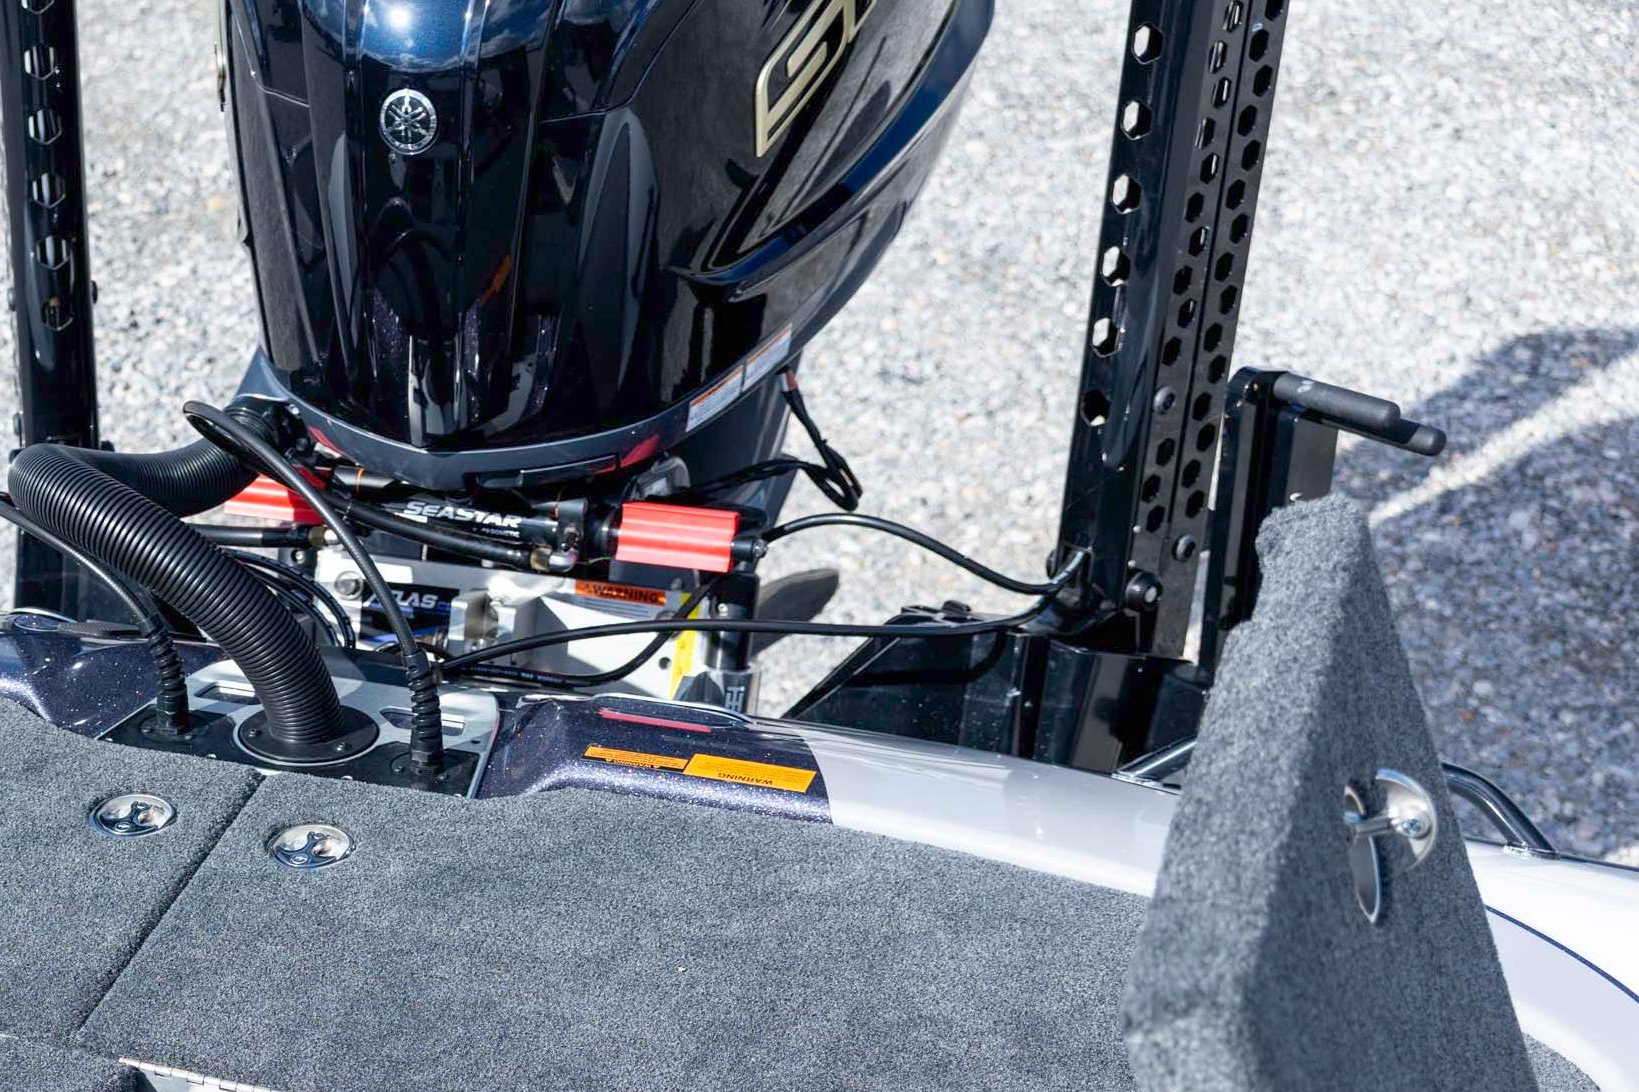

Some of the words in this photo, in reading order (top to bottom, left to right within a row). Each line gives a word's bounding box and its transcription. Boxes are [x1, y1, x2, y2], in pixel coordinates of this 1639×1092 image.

[403, 501, 522, 528] SEASTAR
[593, 585, 659, 604] WARNING
[717, 772, 773, 785] WARNING
